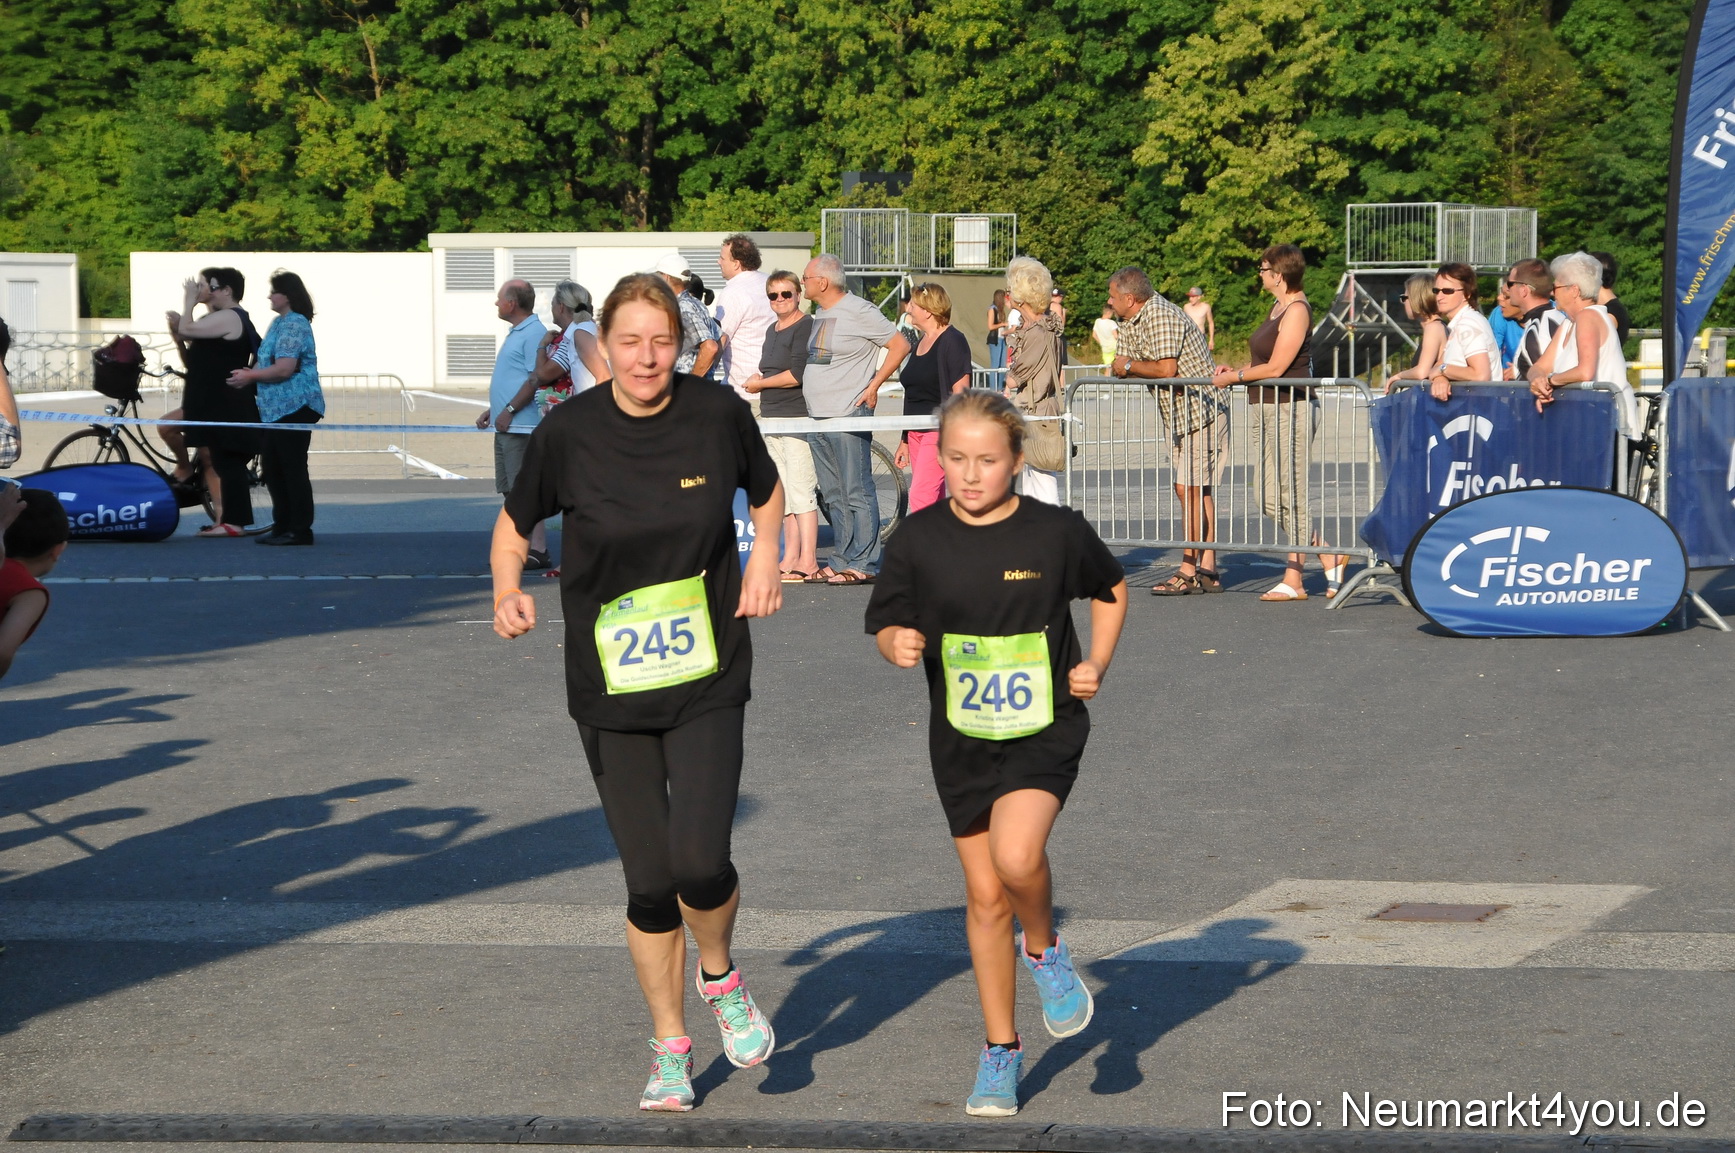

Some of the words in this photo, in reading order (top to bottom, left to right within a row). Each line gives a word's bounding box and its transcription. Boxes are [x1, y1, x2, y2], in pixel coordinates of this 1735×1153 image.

[1693, 98, 1735, 169] Fri
[680, 475, 706, 489] Uschi
[1438, 461, 1562, 507] Fisch
[1003, 569, 1042, 581] Kristina
[1479, 552, 1652, 588] Fischer
[1496, 588, 1639, 606] AUTOMOBILE
[613, 616, 695, 667] 245
[958, 671, 1033, 713] 246
